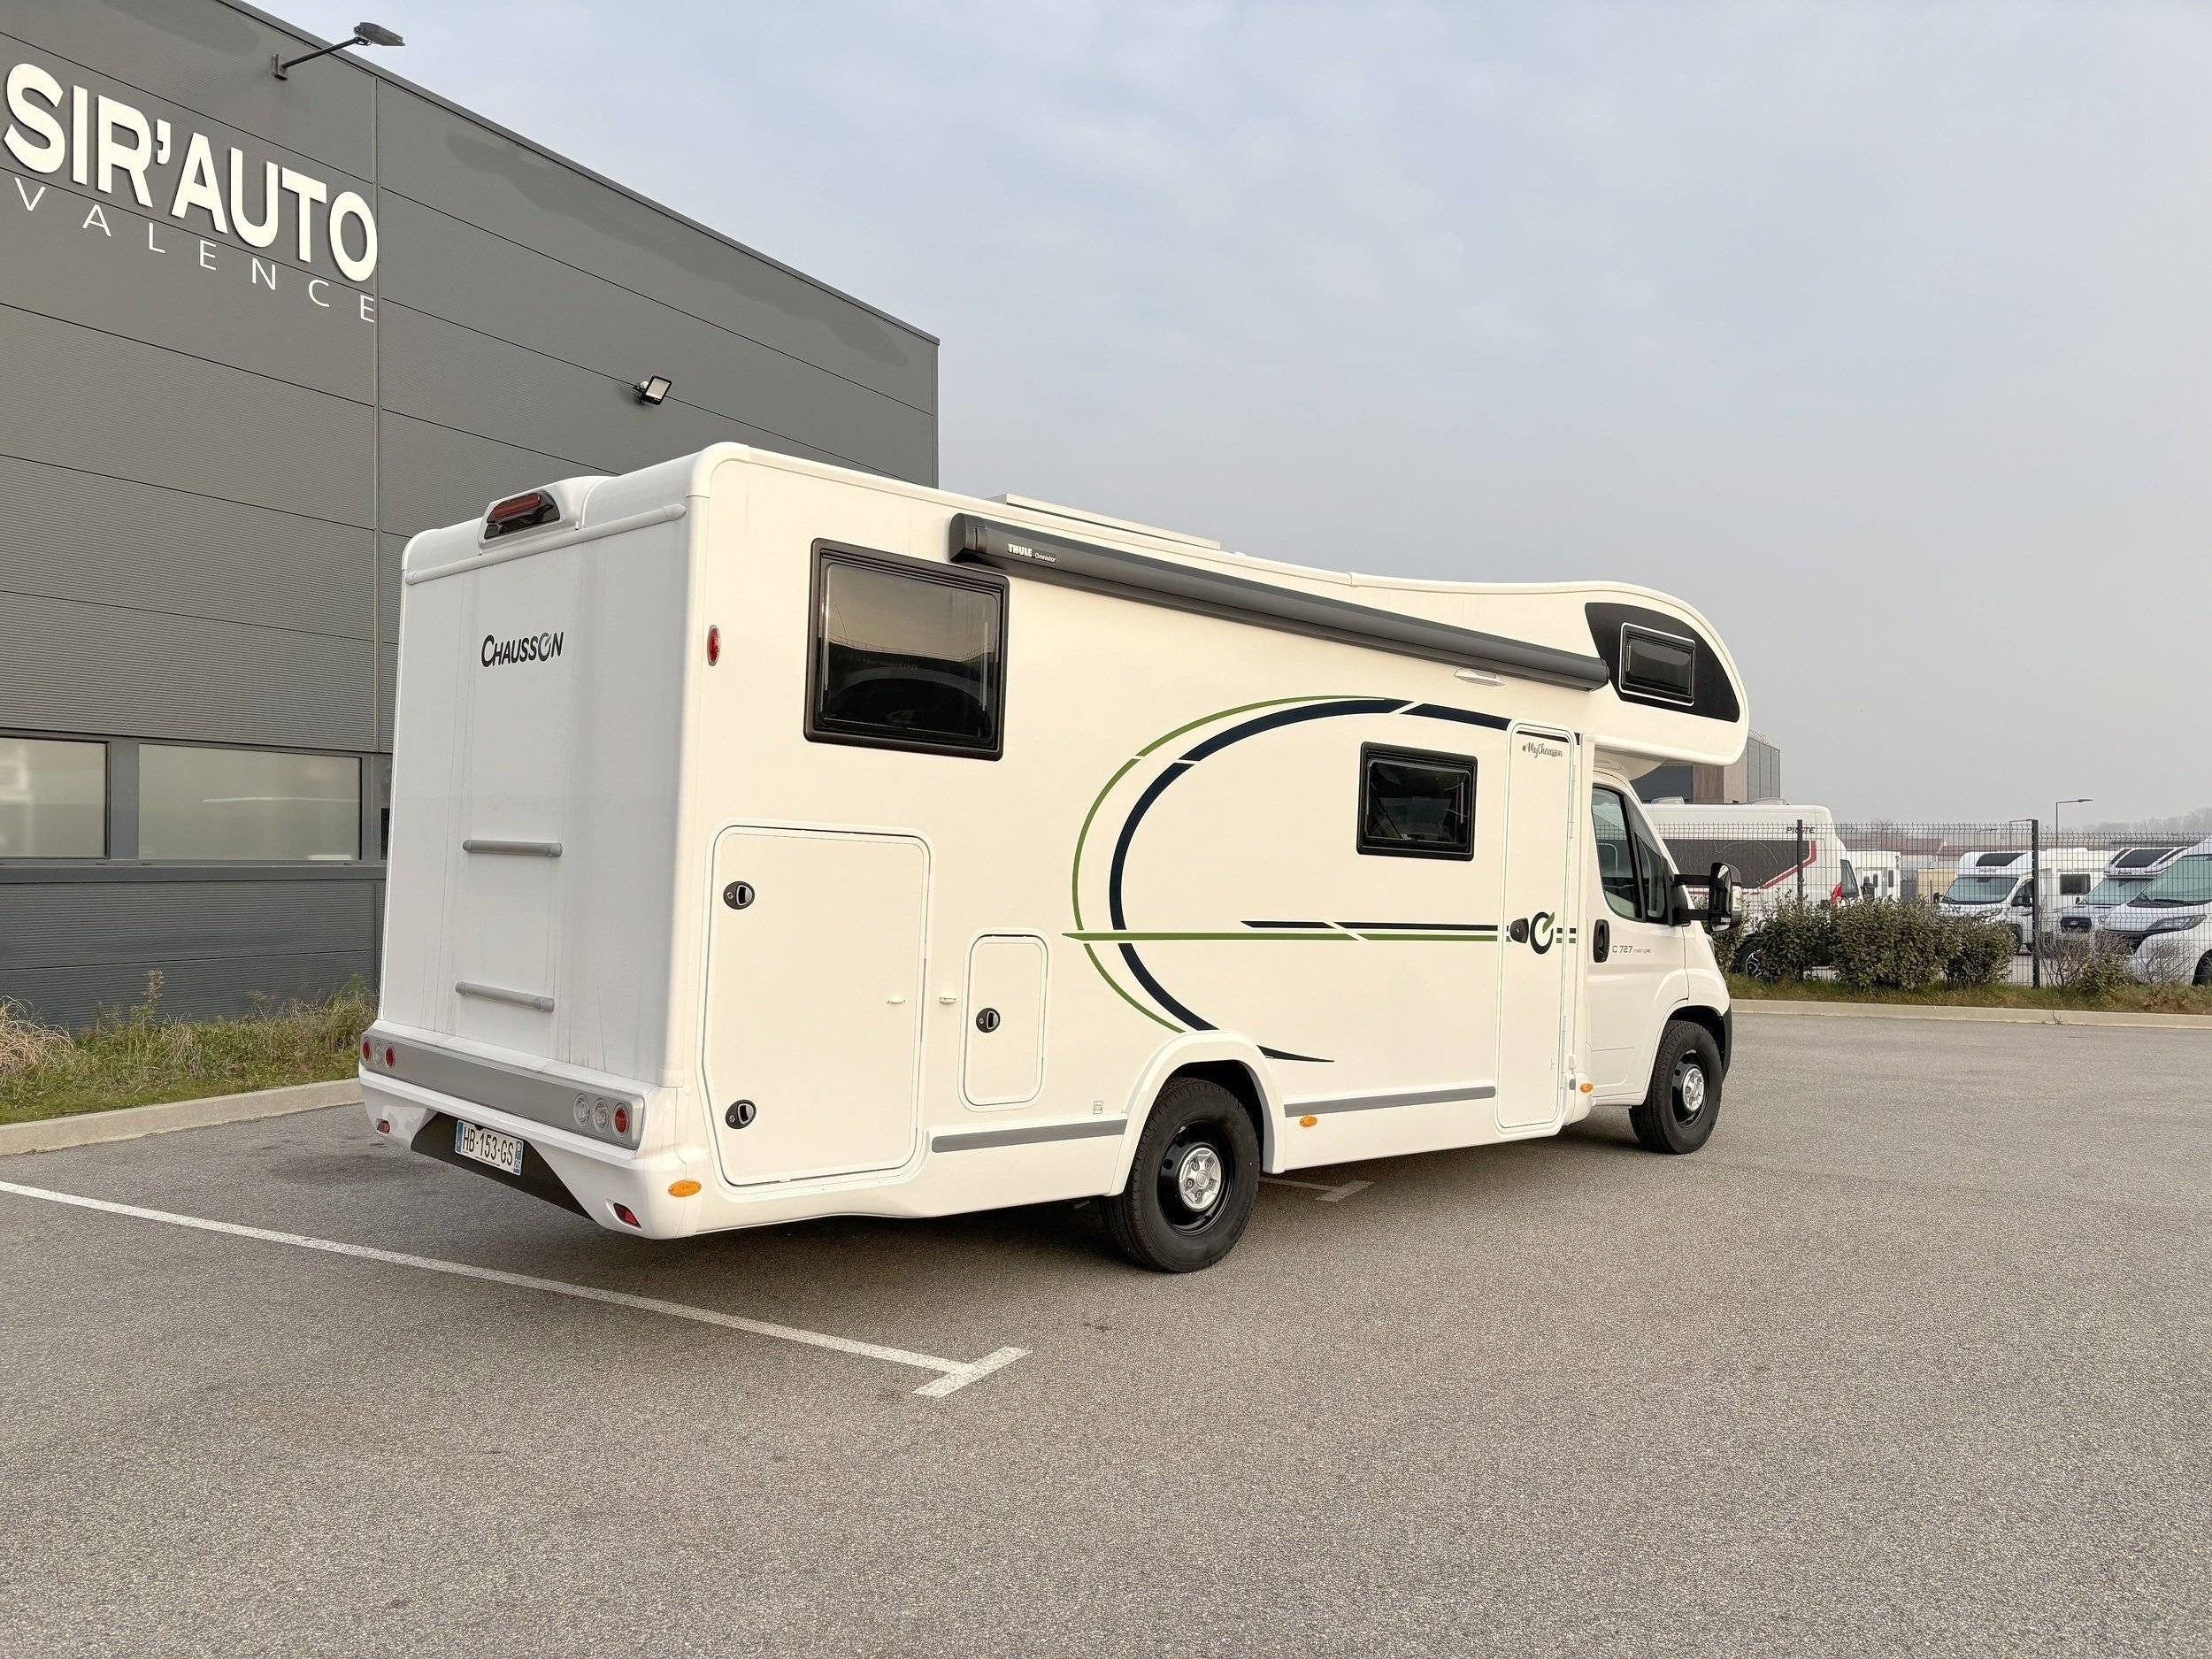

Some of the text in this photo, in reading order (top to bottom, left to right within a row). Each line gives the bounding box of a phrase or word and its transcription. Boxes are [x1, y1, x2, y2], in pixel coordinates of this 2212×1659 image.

[4, 63, 378, 282] SIR'AUTO
[14, 176, 375, 323] VALENCE
[1008, 543, 1033, 557] THULE
[463, 1126, 514, 1166] HB-153-GS
